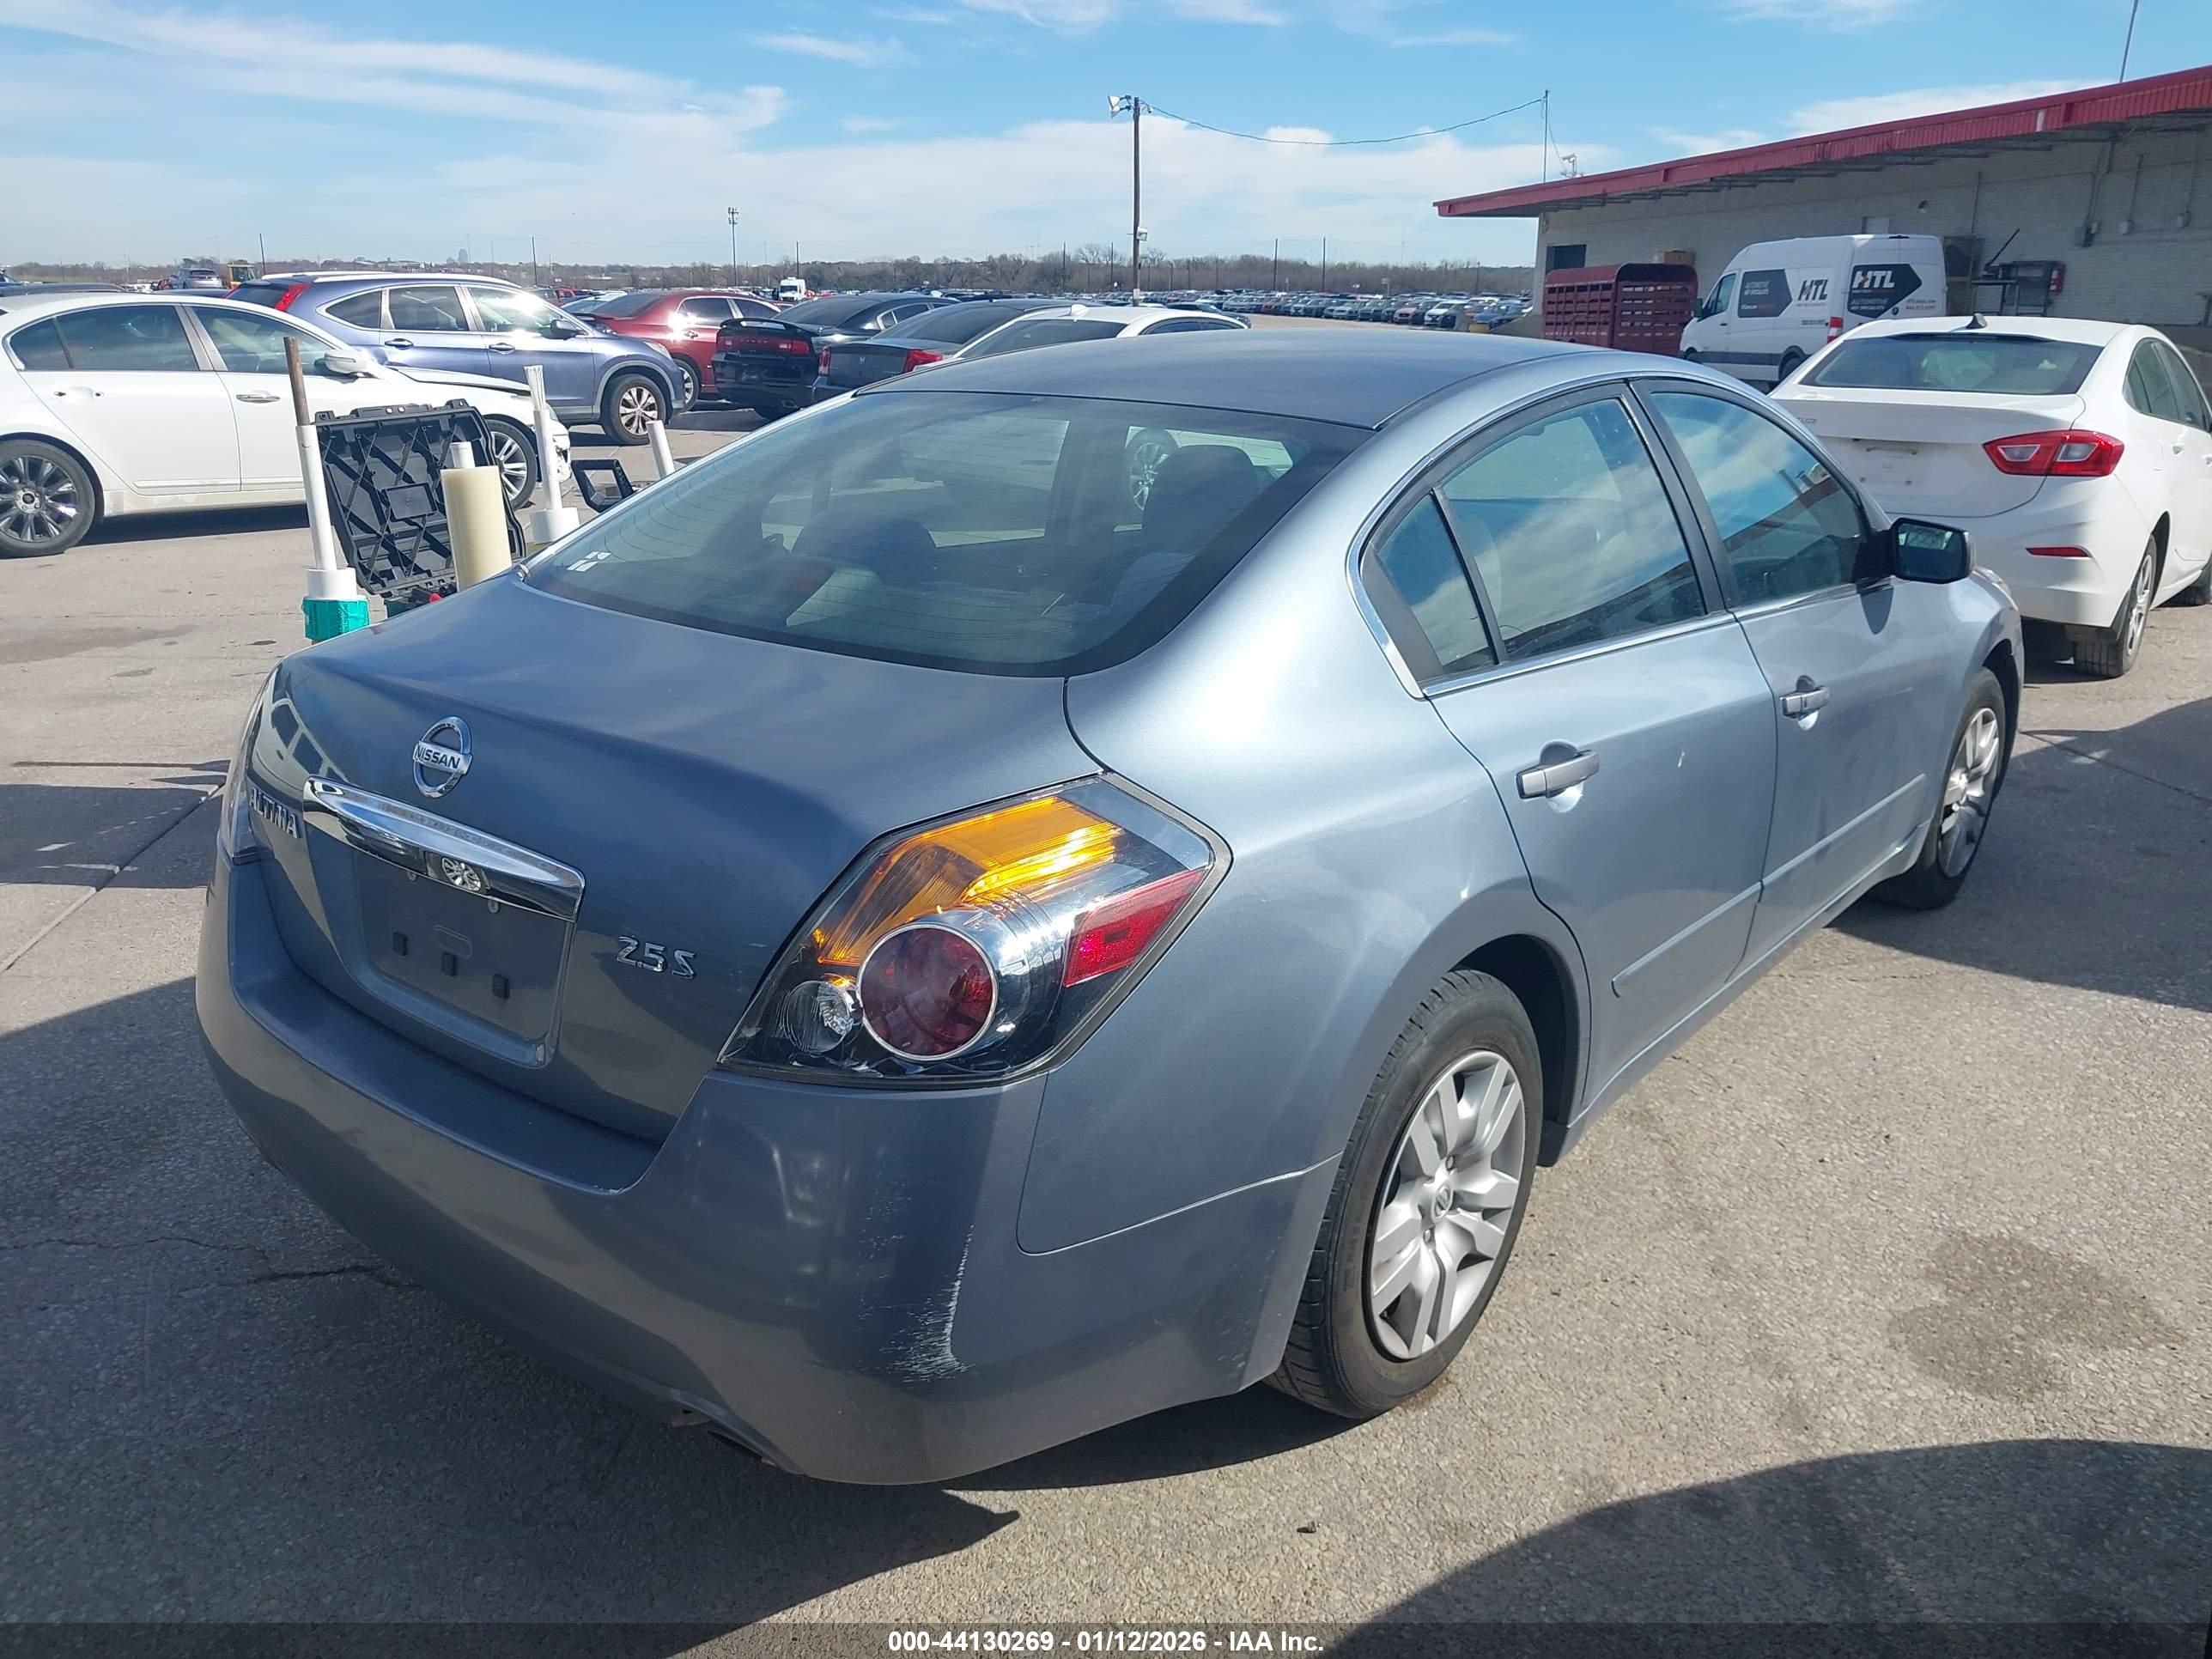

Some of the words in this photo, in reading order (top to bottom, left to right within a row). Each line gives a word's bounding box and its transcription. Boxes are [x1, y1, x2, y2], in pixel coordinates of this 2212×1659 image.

[1797, 279, 1829, 301] HTL
[1852, 270, 1895, 289] HTL
[416, 744, 462, 769] NISSAN
[249, 787, 299, 839] ALTIMA
[617, 935, 666, 972] 2.5
[672, 949, 696, 980] S
